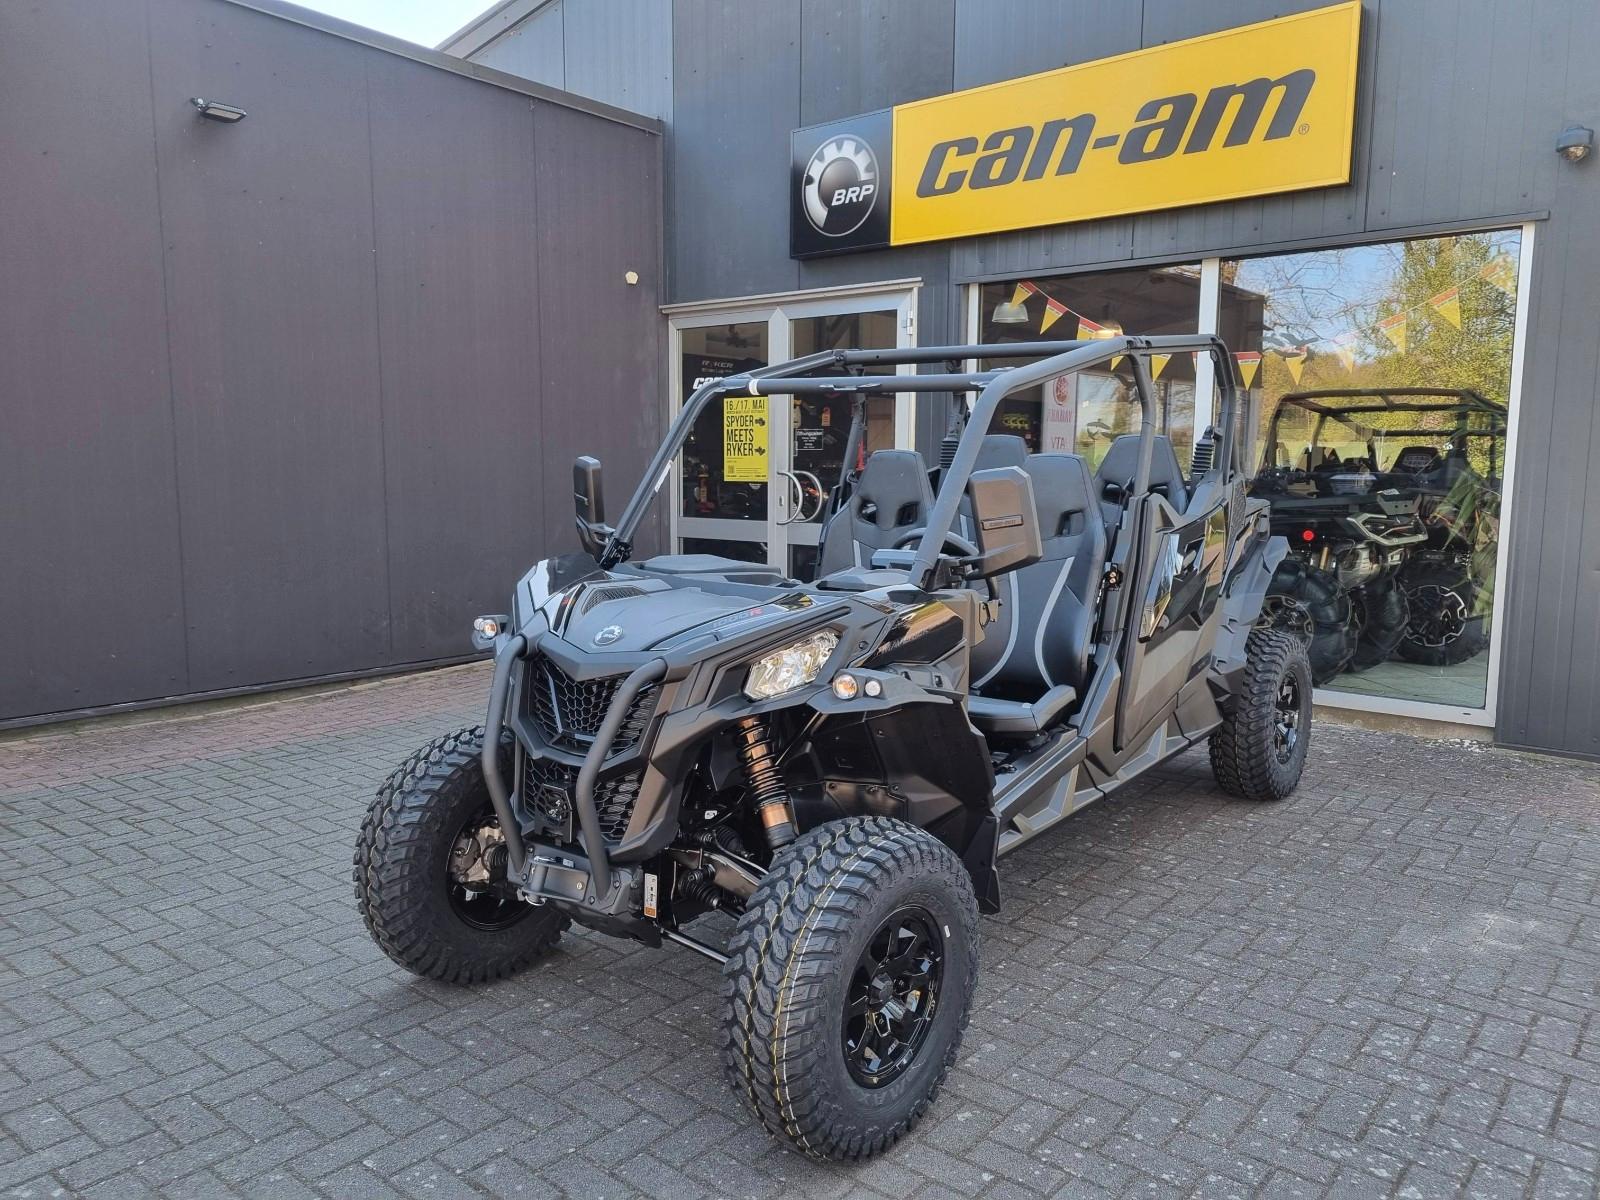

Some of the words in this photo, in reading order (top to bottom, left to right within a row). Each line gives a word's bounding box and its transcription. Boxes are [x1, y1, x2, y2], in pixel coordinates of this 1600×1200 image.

[916, 69, 1316, 199] can-am
[831, 184, 874, 206] BRP
[752, 399, 765, 409] MAI
[726, 414, 754, 428] SPYDER
[726, 428, 754, 443] MEETS
[726, 442, 754, 457] RYKER
